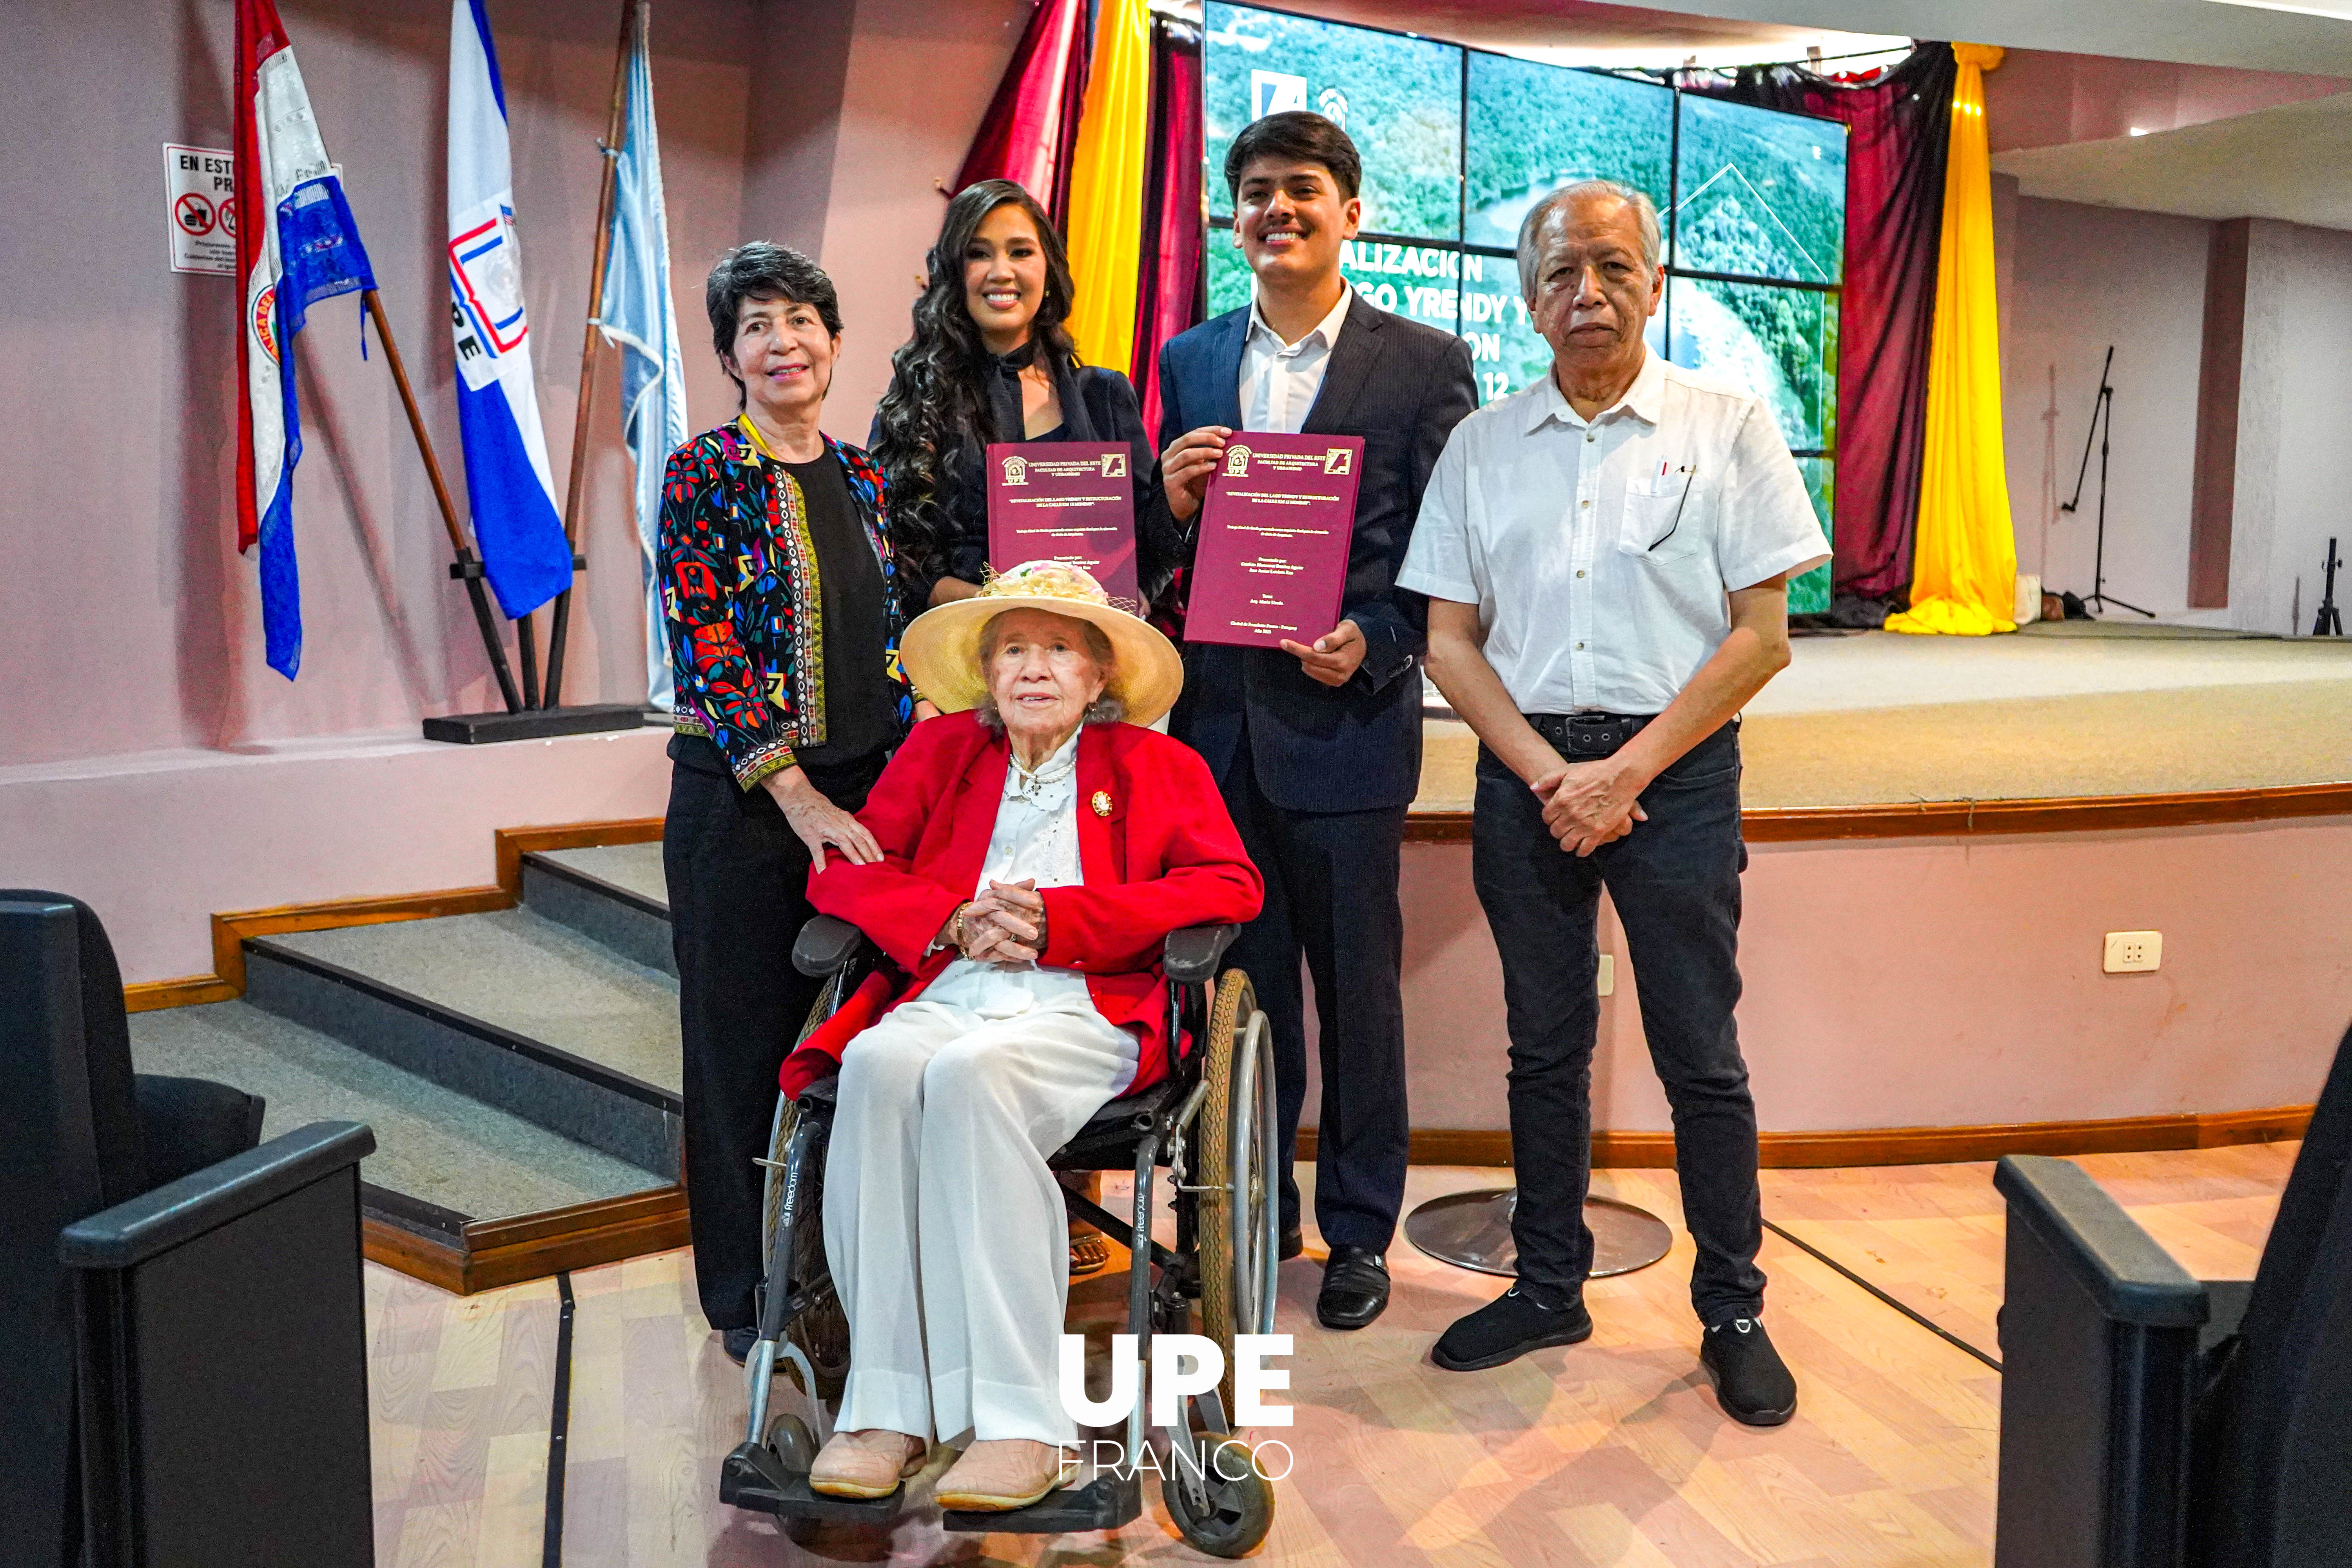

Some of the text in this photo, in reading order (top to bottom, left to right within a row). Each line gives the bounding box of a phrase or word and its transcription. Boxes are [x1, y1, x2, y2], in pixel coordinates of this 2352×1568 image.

[180, 155, 233, 174] EN EST
[214, 176, 233, 192] PR
[1339, 240, 1482, 281] ALIZACION
[1355, 281, 1527, 325] GO YRENDY Y
[1456, 330, 1500, 362] ON
[1483, 372, 1509, 400] 12
[784, 1172, 799, 1210] freedom
